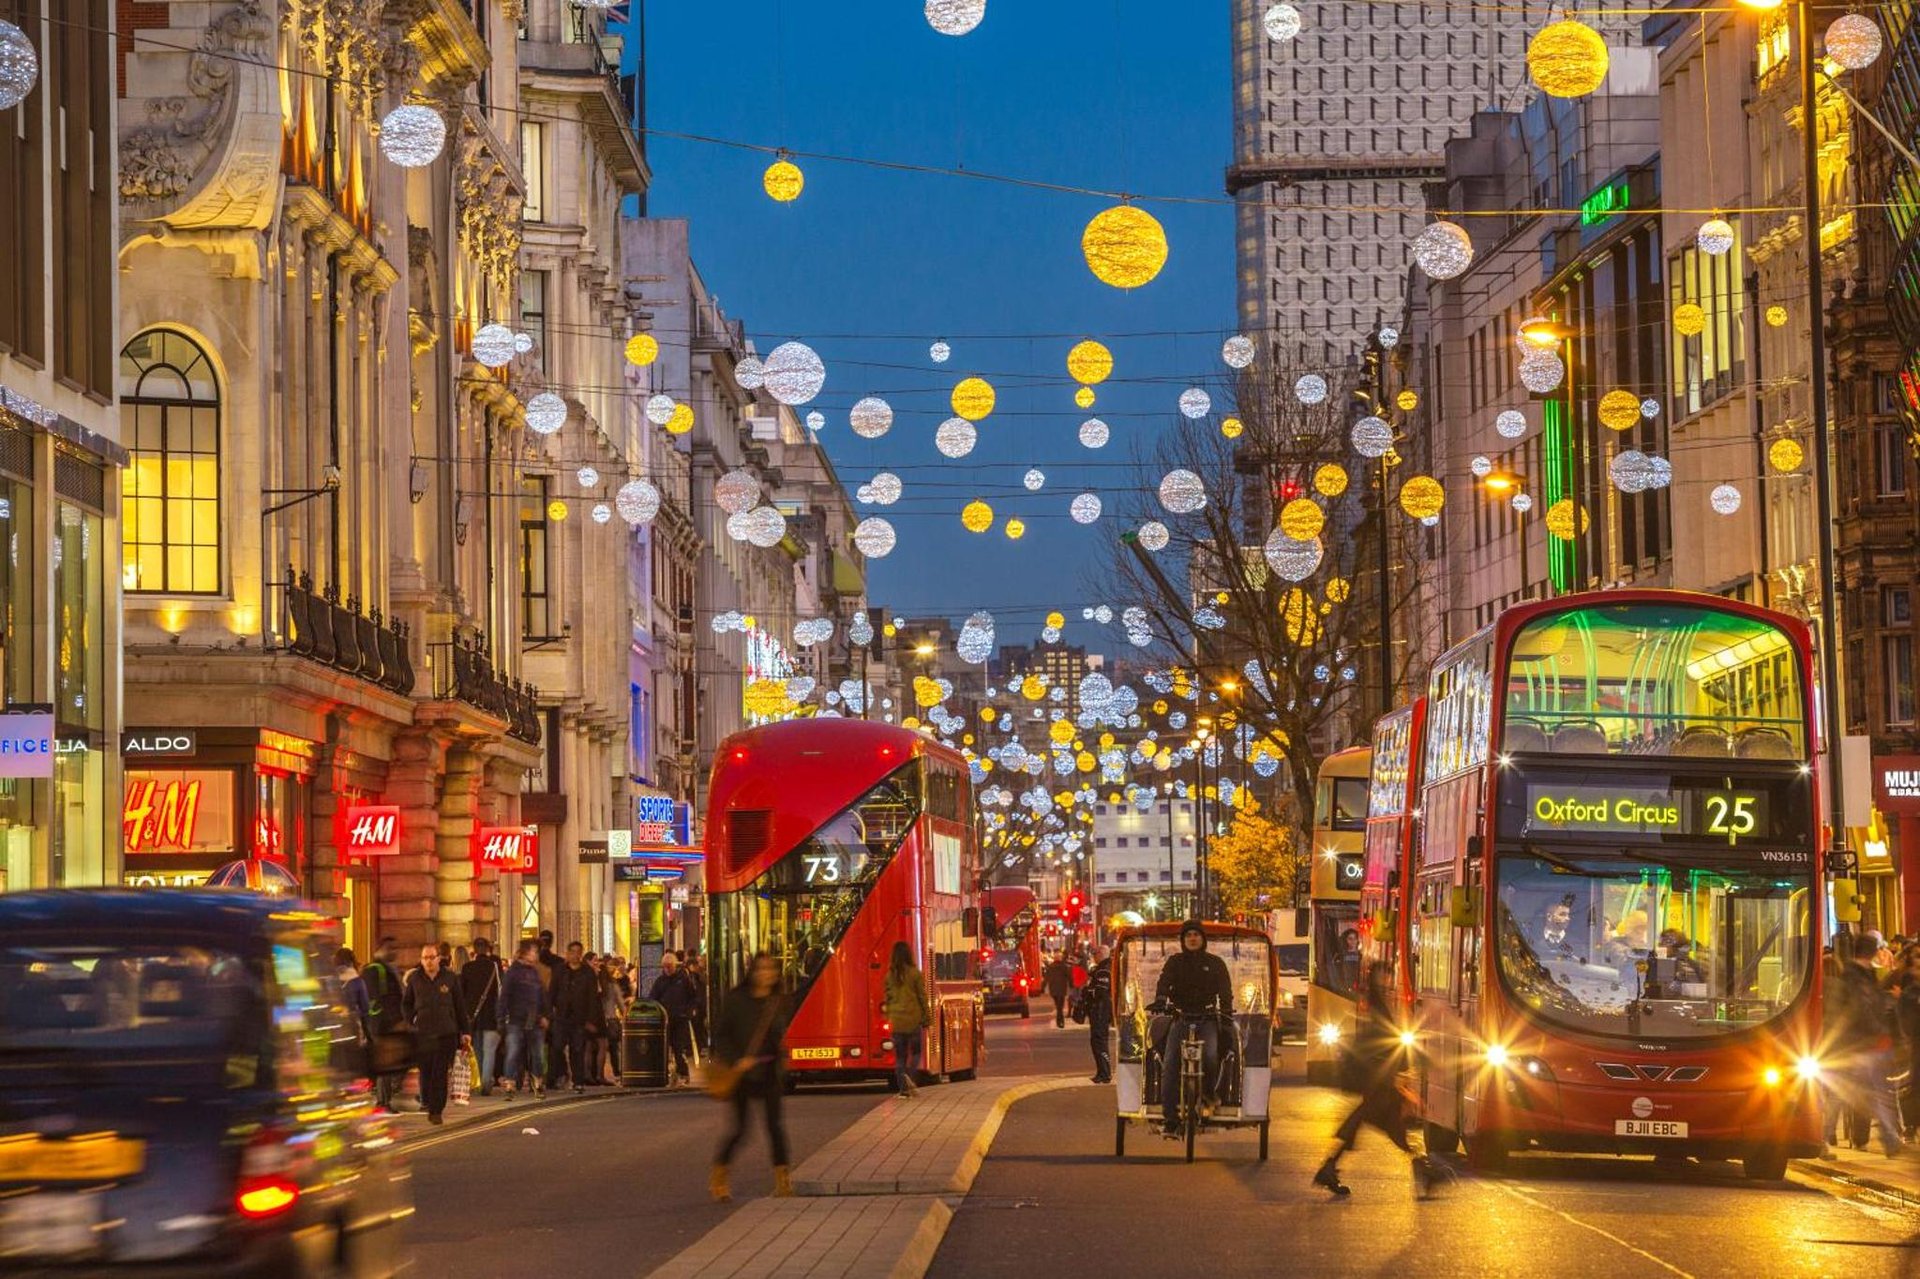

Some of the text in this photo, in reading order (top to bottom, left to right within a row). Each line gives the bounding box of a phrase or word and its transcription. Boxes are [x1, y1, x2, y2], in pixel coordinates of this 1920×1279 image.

[126, 737, 191, 751] ALDO
[124, 780, 201, 850] H&M
[639, 796, 674, 822] SPORTS
[1535, 797, 1678, 825] Oxford Circus
[1706, 796, 1756, 835] 25
[351, 815, 395, 845] H&M
[483, 834, 521, 860] H&M
[579, 847, 606, 856] Dune
[1761, 851, 1808, 862] VN36151
[804, 857, 839, 882] 73
[1346, 863, 1363, 878] Ox
[1653, 1122, 1678, 1136] EBC
